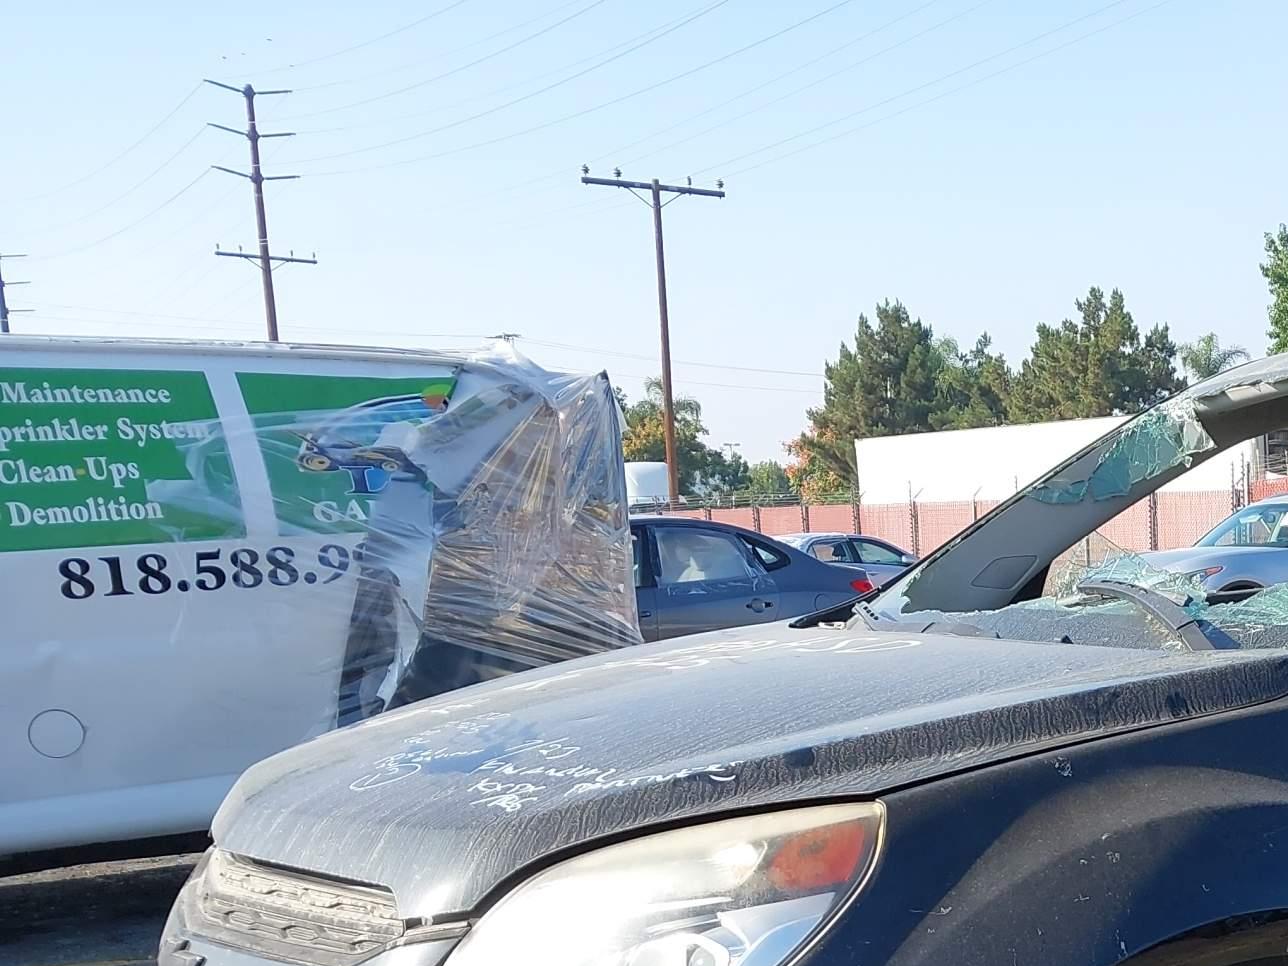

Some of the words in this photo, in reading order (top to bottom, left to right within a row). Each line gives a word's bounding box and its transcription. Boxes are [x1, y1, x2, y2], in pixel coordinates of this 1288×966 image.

[0, 381, 171, 404] Maintenance
[0, 417, 109, 451] prinkler
[5, 495, 164, 526] Demolition
